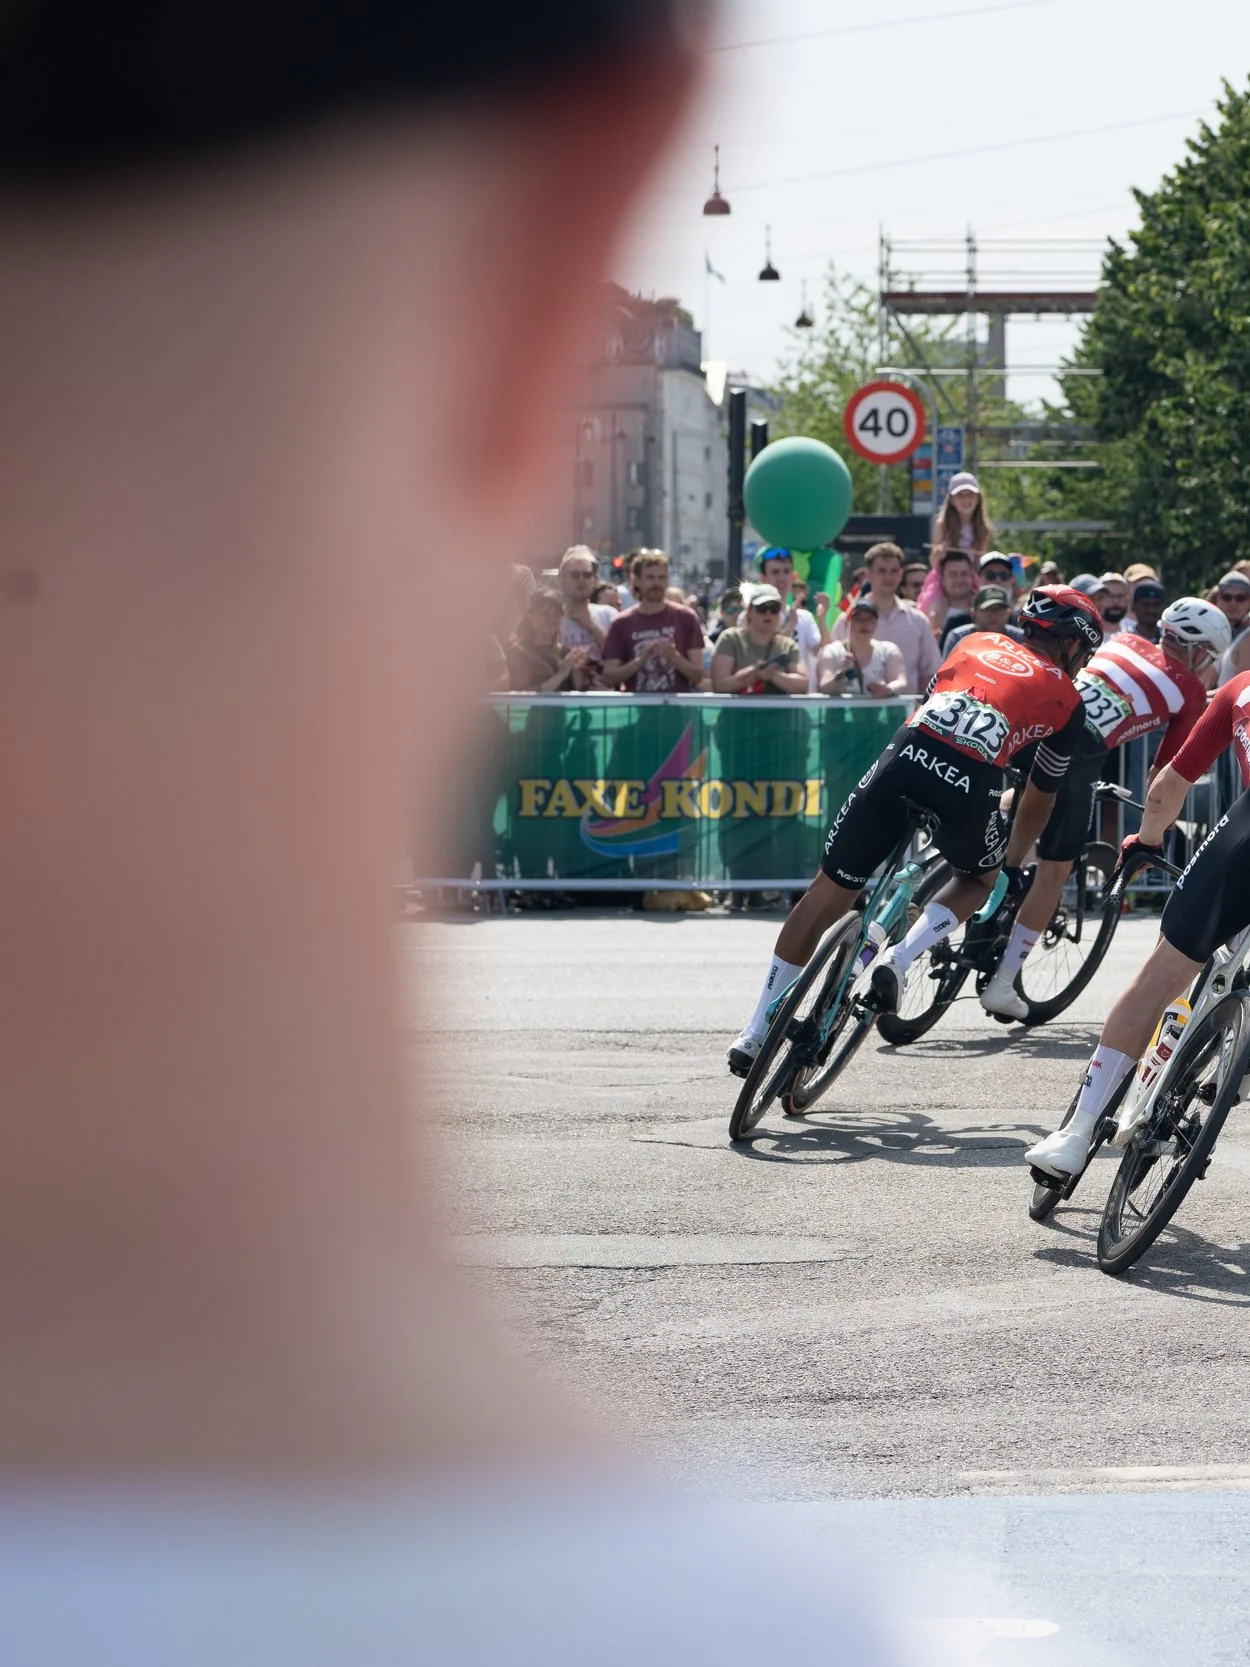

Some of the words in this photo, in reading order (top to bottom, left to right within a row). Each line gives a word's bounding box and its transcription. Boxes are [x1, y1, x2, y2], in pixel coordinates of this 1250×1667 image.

[858, 408, 909, 437] 40
[962, 709, 1008, 753] 123
[899, 744, 971, 793] ARKEA
[518, 778, 646, 818] FAXE
[661, 779, 826, 819] KONDI
[824, 792, 857, 856] ARKEA
